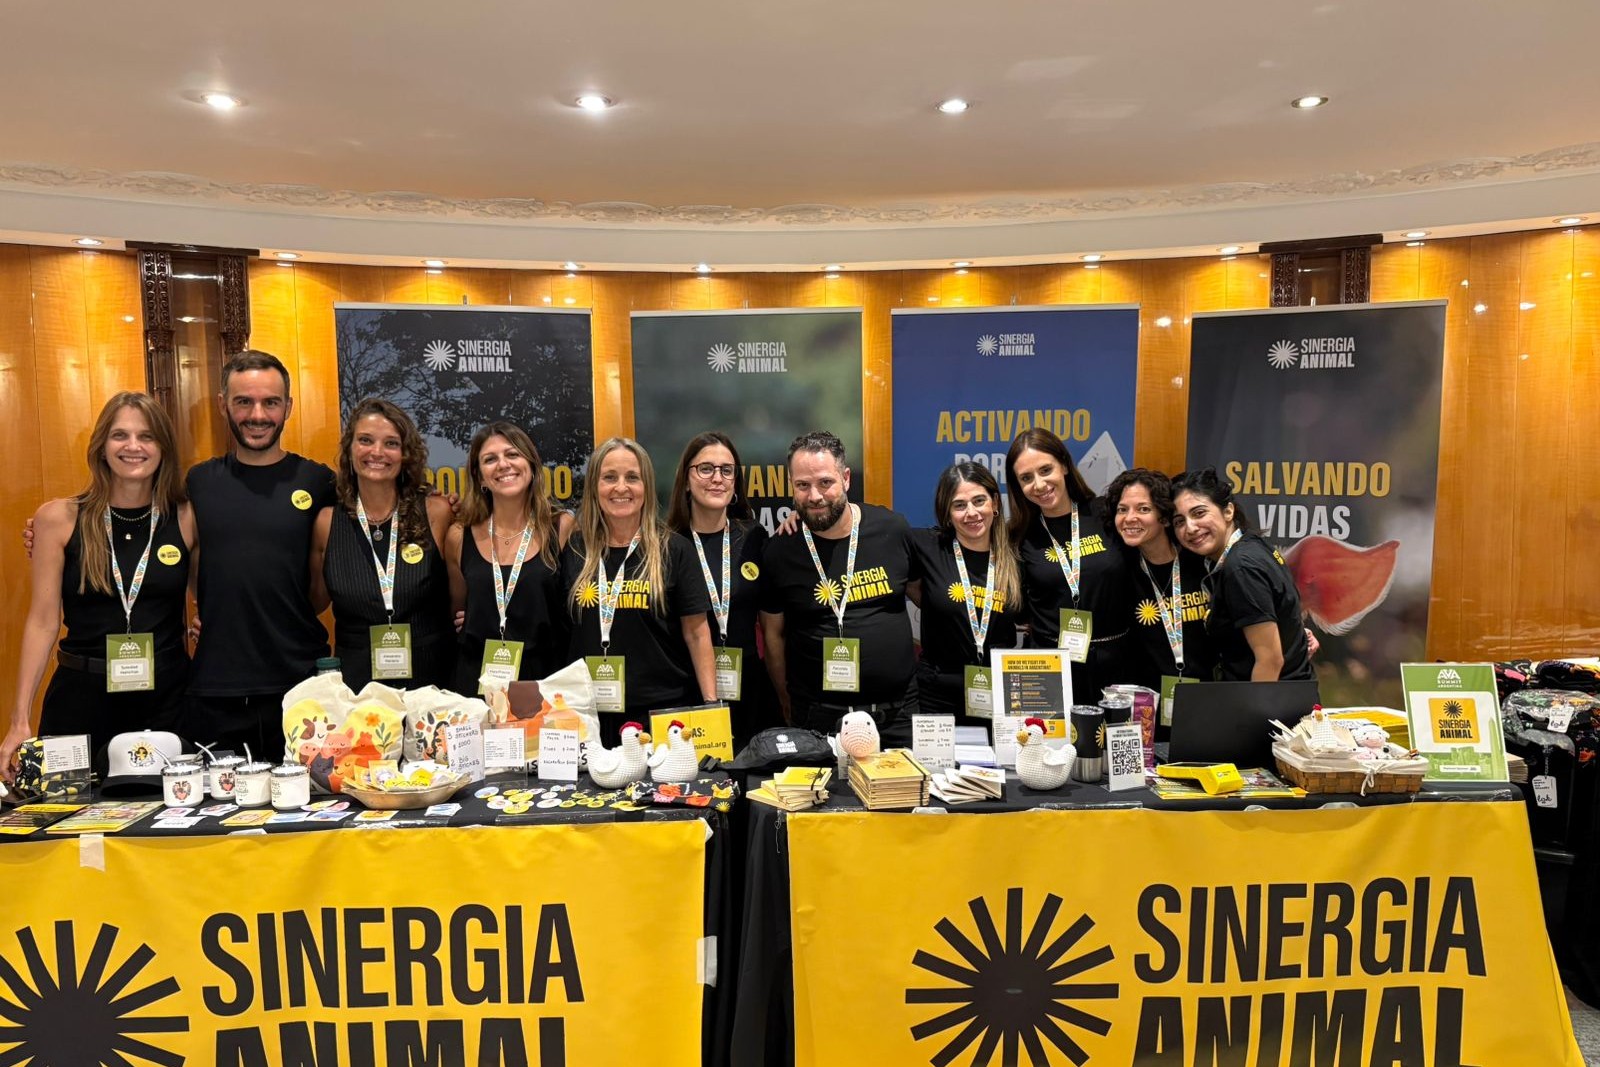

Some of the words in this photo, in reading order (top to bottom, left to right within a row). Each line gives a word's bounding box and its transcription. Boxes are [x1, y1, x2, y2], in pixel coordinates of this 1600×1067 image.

[999, 333, 1035, 345] SINERGIA
[1300, 337, 1356, 354] SINERGIA
[457, 339, 512, 356] SINERGIA
[738, 342, 787, 357] SINERGIA
[998, 345, 1035, 356] ANIMAL
[458, 356, 513, 372] ANIMAL
[738, 357, 788, 373] ANIMAL
[1300, 352, 1355, 369] ANIMAL
[936, 408, 1091, 443] ACTIVANDO
[1225, 460, 1391, 497] SALVANDO
[1258, 504, 1351, 540] VIDAS
[1065, 534, 1102, 550] SERGIA
[840, 566, 888, 588] SNERGIA
[606, 580, 650, 594] SERGIA
[1438, 668, 1461, 679] AVA
[1438, 720, 1471, 729] SINERGIA
[1440, 730, 1472, 739] ANIMAL
[1134, 876, 1488, 984] SINERGIA
[200, 904, 585, 1016] SINERGIA
[1132, 986, 1483, 1067] ANIMAL
